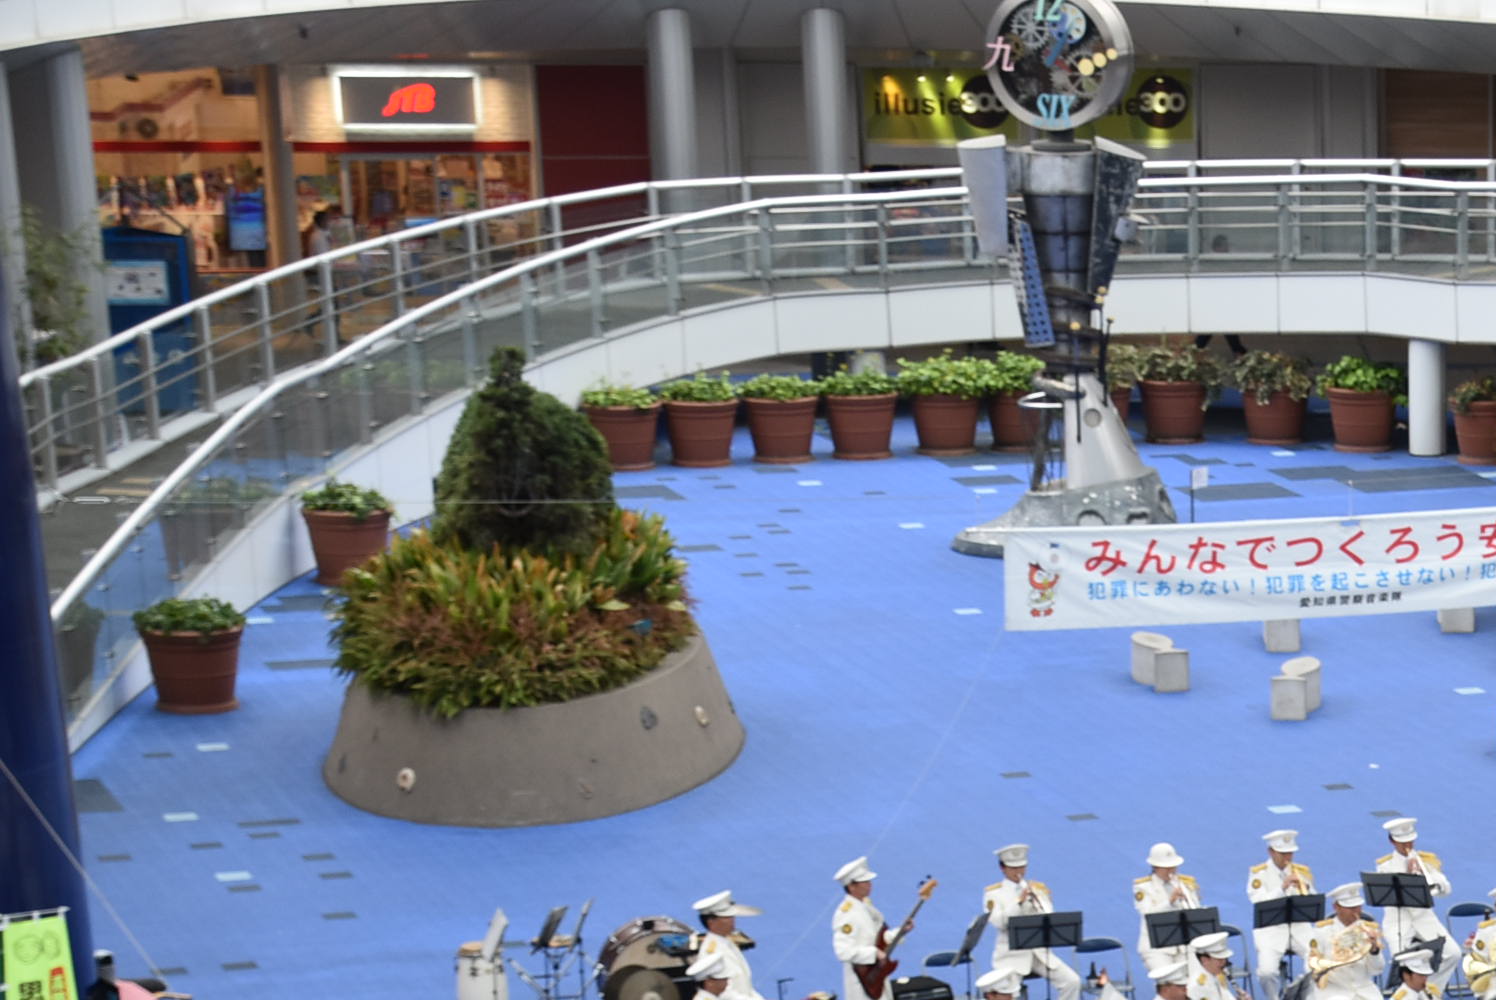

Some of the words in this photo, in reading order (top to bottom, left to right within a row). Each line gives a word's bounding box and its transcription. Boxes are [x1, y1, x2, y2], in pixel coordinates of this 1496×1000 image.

[981, 36, 1015, 72] 九
[381, 82, 436, 117] JTB
[1035, 93, 1076, 126] SIX
